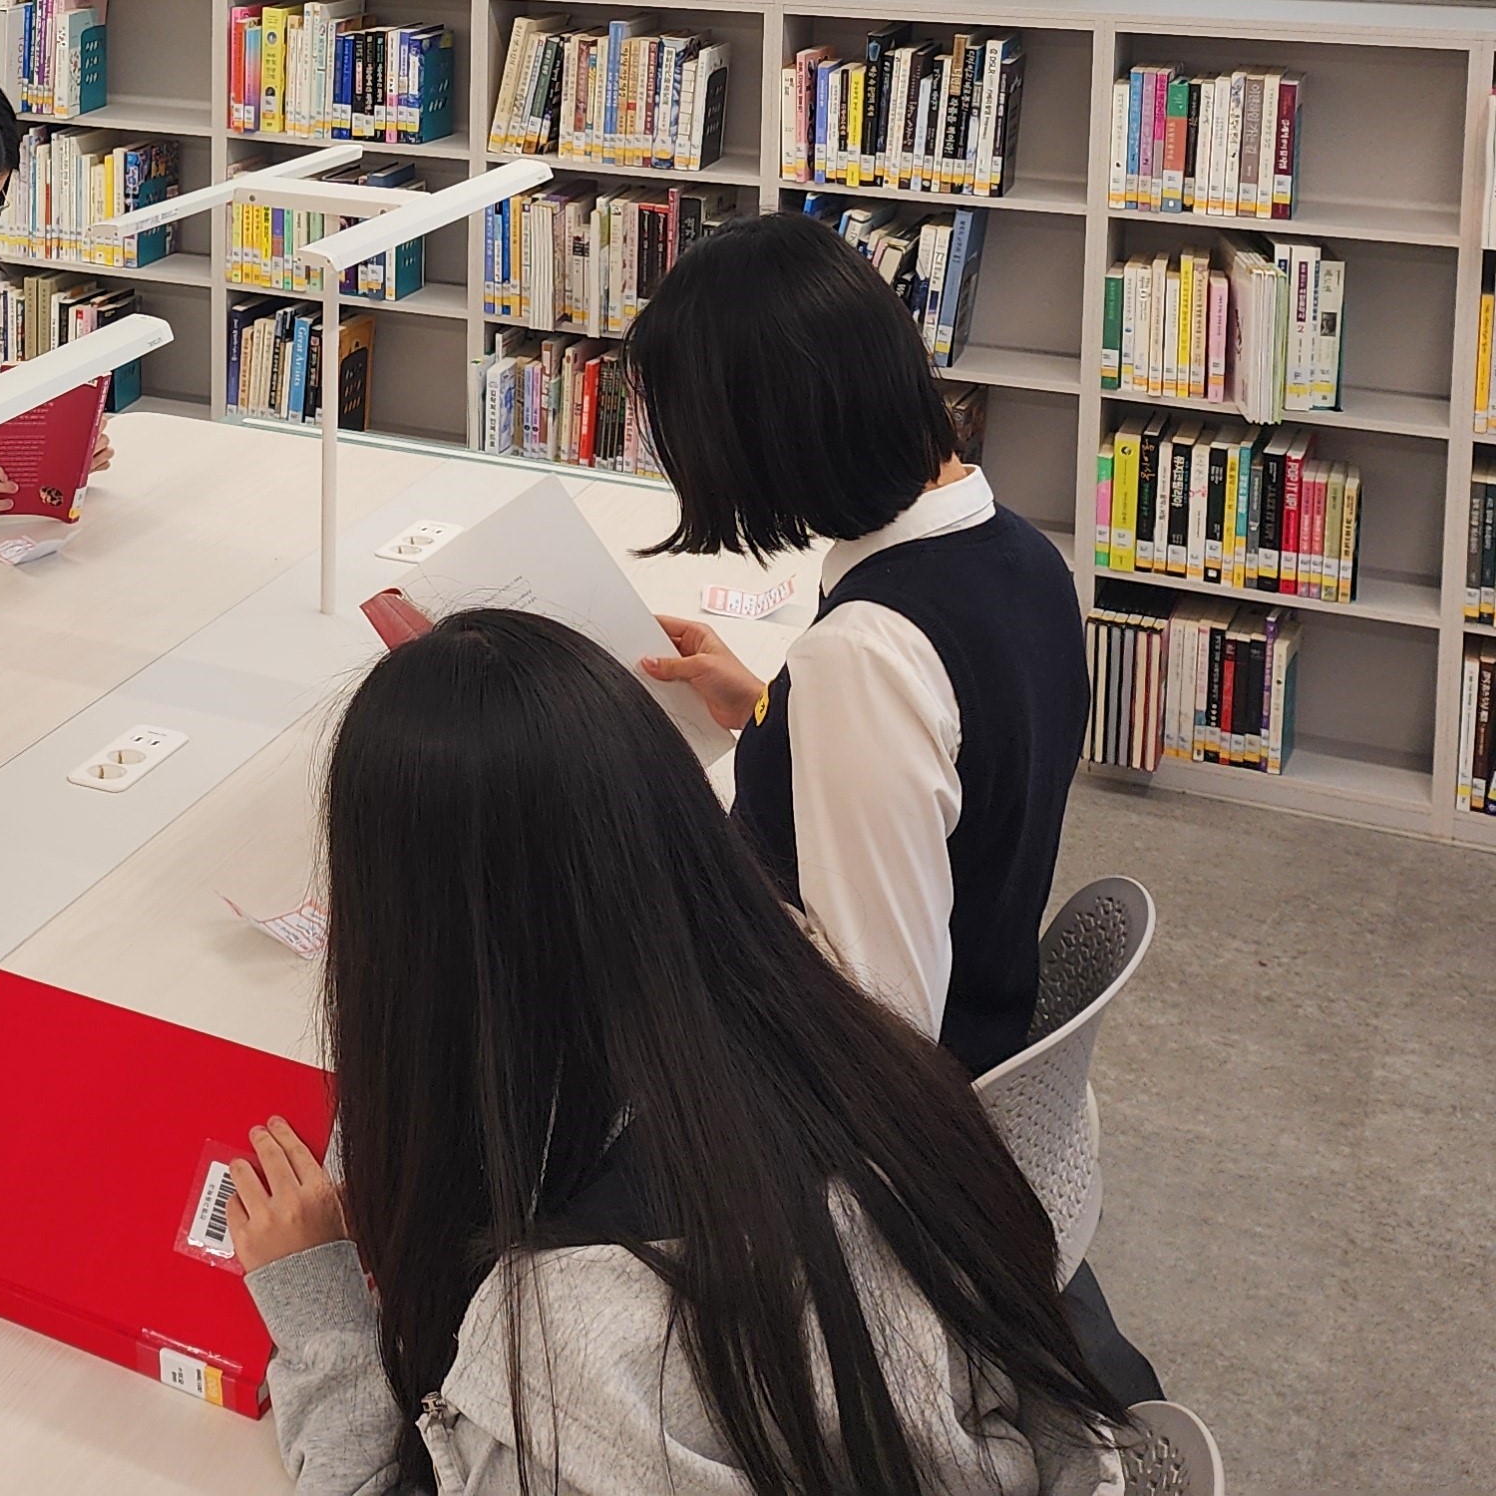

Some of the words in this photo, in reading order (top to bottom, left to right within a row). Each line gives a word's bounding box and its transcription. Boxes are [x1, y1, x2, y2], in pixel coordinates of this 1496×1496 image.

[987, 56, 996, 74] DSLR
[296, 326, 306, 352] Great
[1287, 462, 1299, 482] POP
[1285, 493, 1298, 510] UP!
